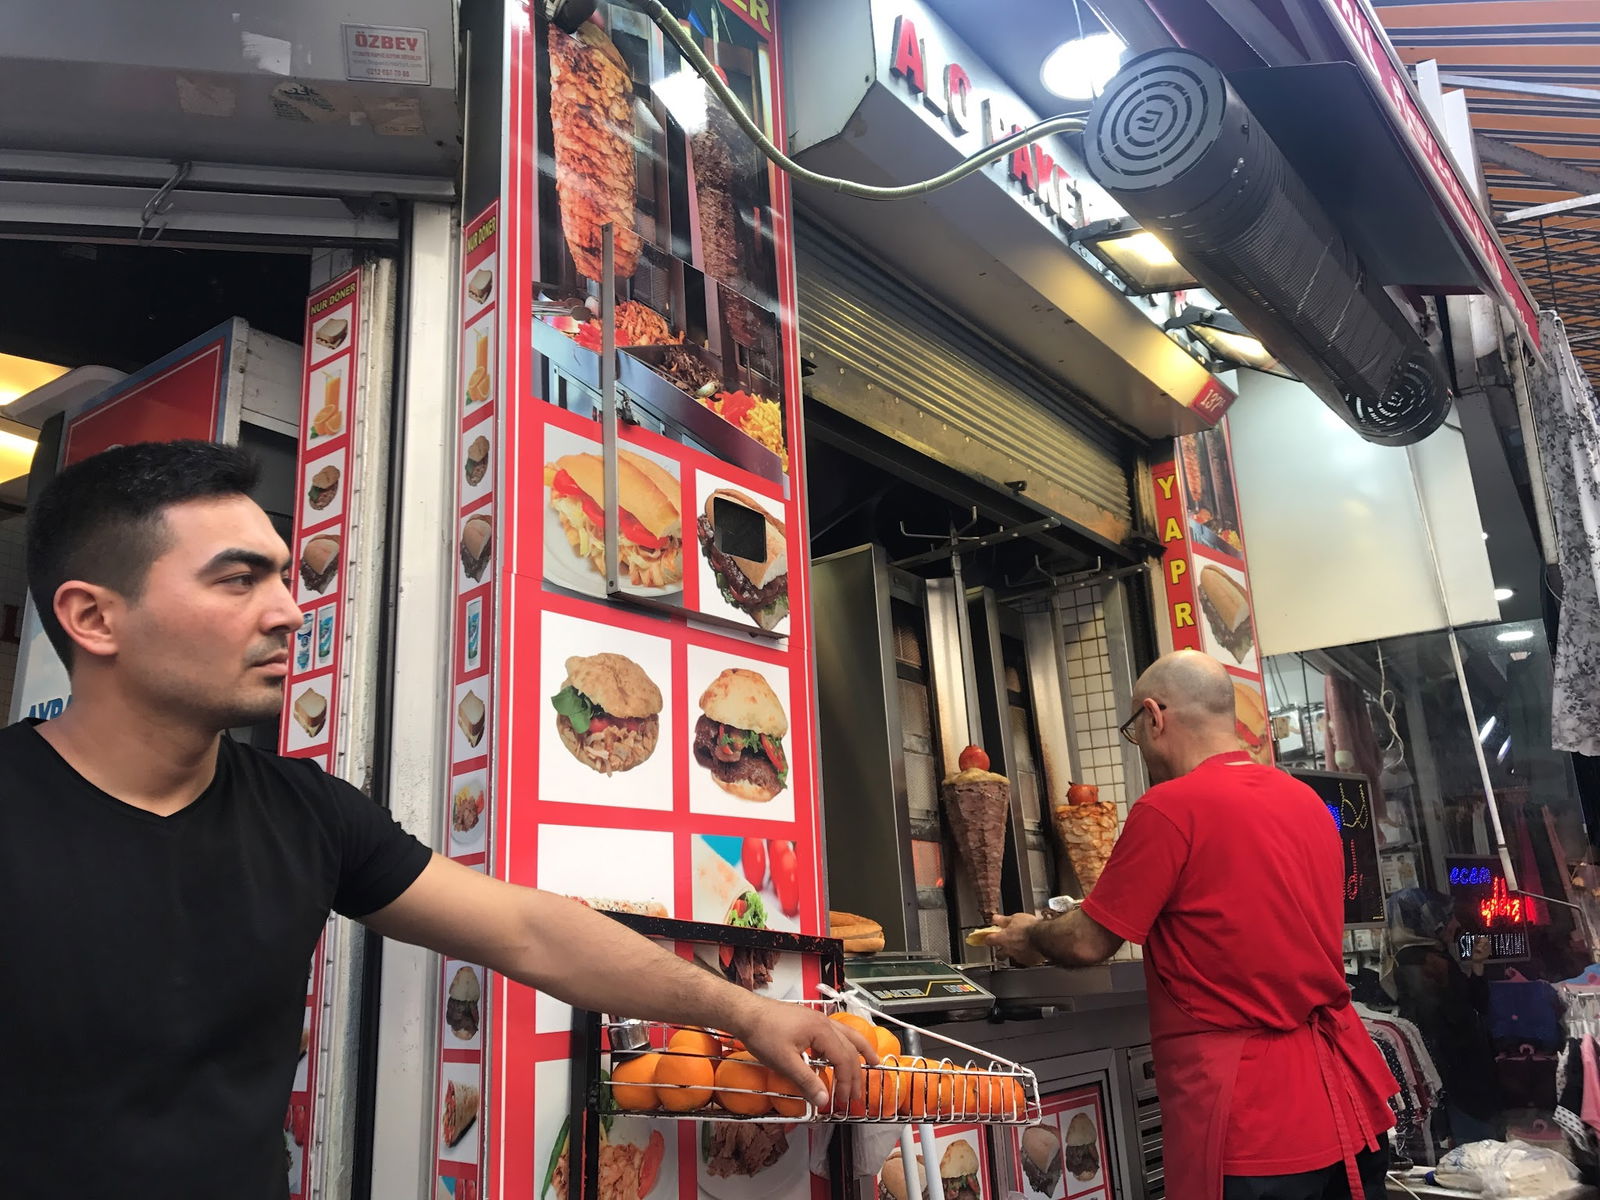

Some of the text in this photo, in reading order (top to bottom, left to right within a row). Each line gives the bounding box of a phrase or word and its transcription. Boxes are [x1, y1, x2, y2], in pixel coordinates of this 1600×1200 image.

[355, 31, 418, 51] ÖZBEY
[310, 282, 356, 316] NUR DÖNER
[1157, 474, 1196, 651] YAPR
